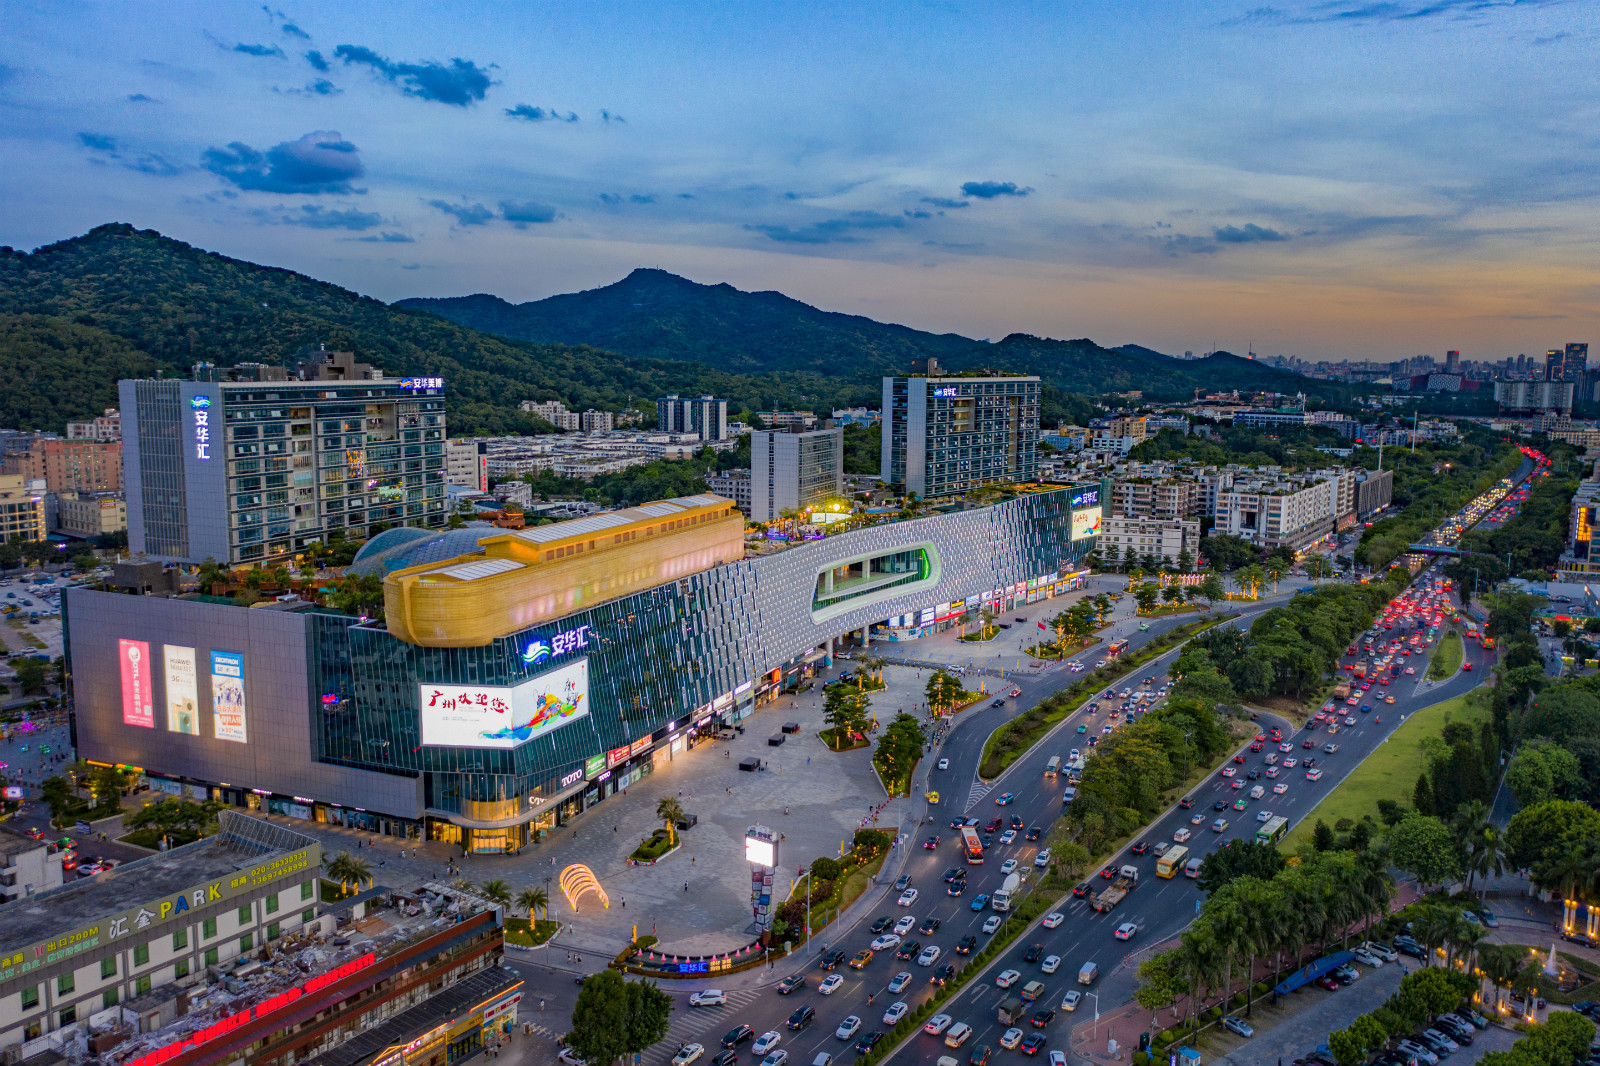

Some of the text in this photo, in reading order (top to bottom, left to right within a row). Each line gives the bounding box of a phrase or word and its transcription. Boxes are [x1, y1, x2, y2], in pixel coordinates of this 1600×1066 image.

[195, 410, 211, 460] 安华汇
[1082, 491, 1098, 504] 安华汇
[551, 625, 589, 657] 安华汇
[428, 690, 510, 714] 广州欢迎您
[561, 768, 583, 787] TOTO
[598, 770, 611, 782] TOTO
[109, 882, 223, 939] 汇金 PARK
[679, 962, 708, 973] 安华汇
